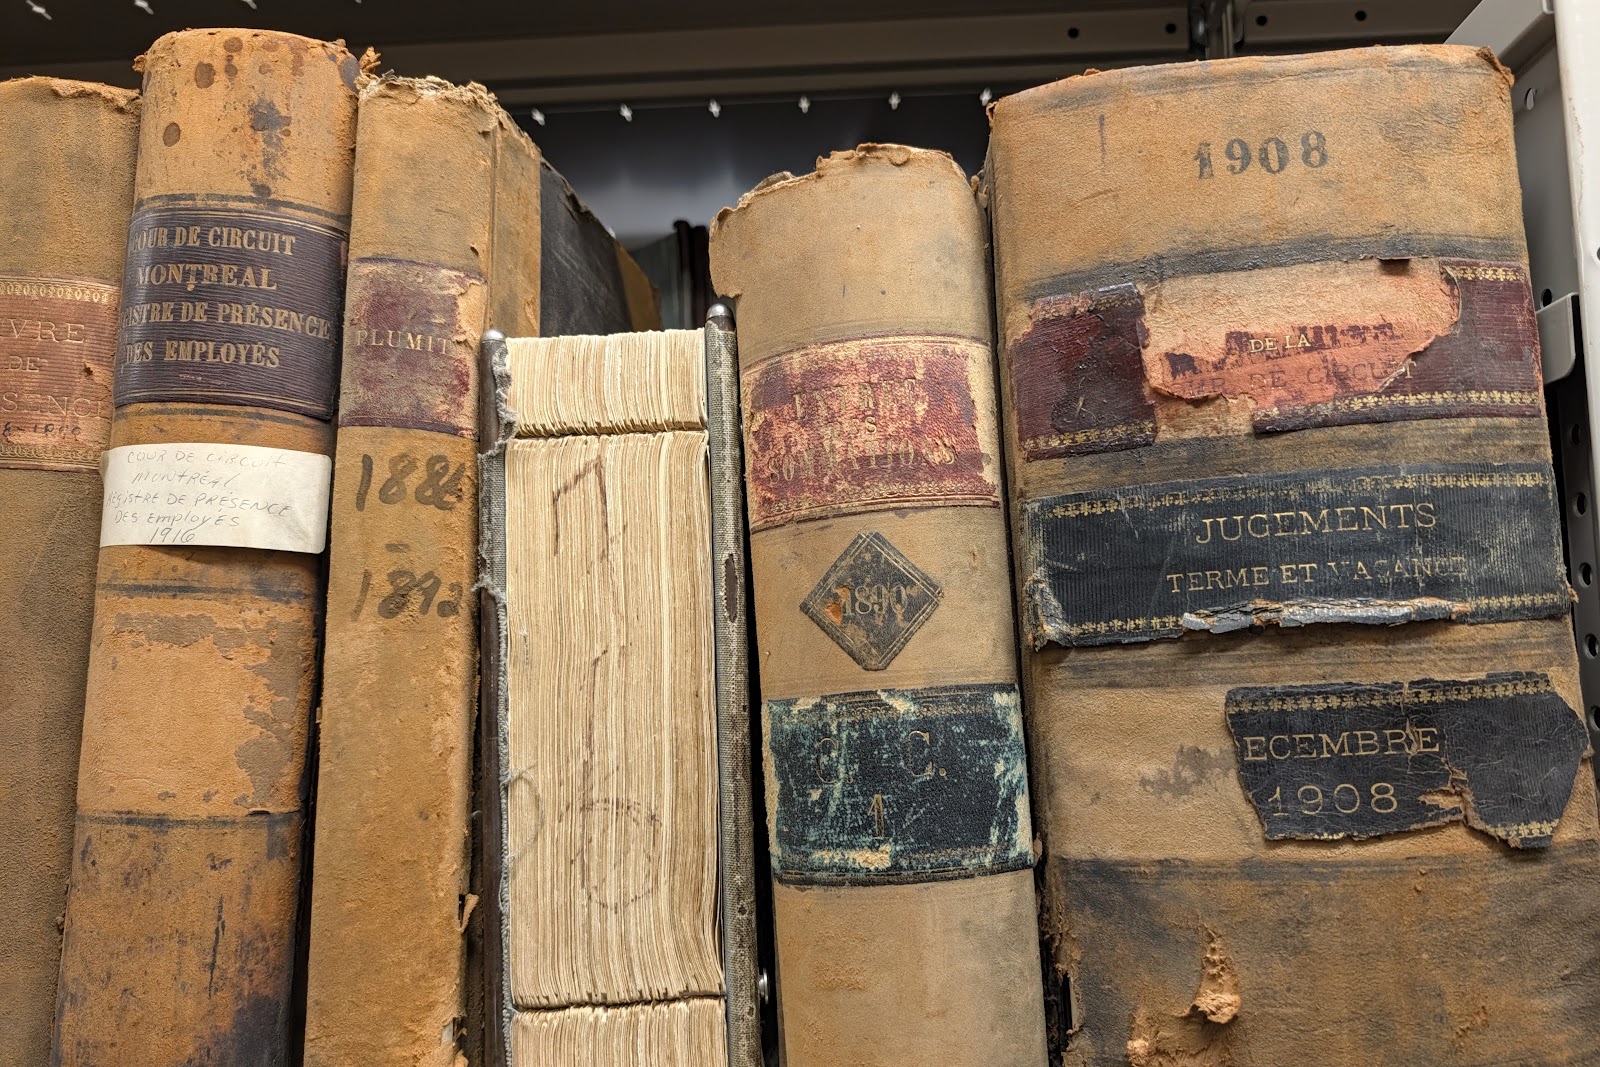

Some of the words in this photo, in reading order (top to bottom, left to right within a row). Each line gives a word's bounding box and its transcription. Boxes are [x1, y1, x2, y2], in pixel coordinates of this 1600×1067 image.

[1194, 130, 1329, 180] 1908
[174, 225, 201, 248] DE
[208, 226, 297, 256] CIRCUIT
[181, 301, 209, 323] DE
[216, 301, 331, 340] PRÉSENCE
[125, 341, 154, 364] DES
[163, 339, 281, 369] EMPLOYÉS
[1249, 337, 1278, 354] DE
[1284, 334, 1312, 351] LA
[7, 355, 41, 373] DE
[126, 450, 169, 464] COUR
[174, 450, 195, 463] DE
[167, 493, 188, 505] DE
[114, 510, 140, 525] DES
[1195, 500, 1439, 546] JUGEMENTS
[149, 527, 198, 543] 1916
[1165, 565, 1271, 595] TERME
[1279, 563, 1318, 585] ET
[840, 583, 909, 617] 1890
[1242, 727, 1441, 762] ECEMBRE
[1266, 781, 1399, 818] 1908
